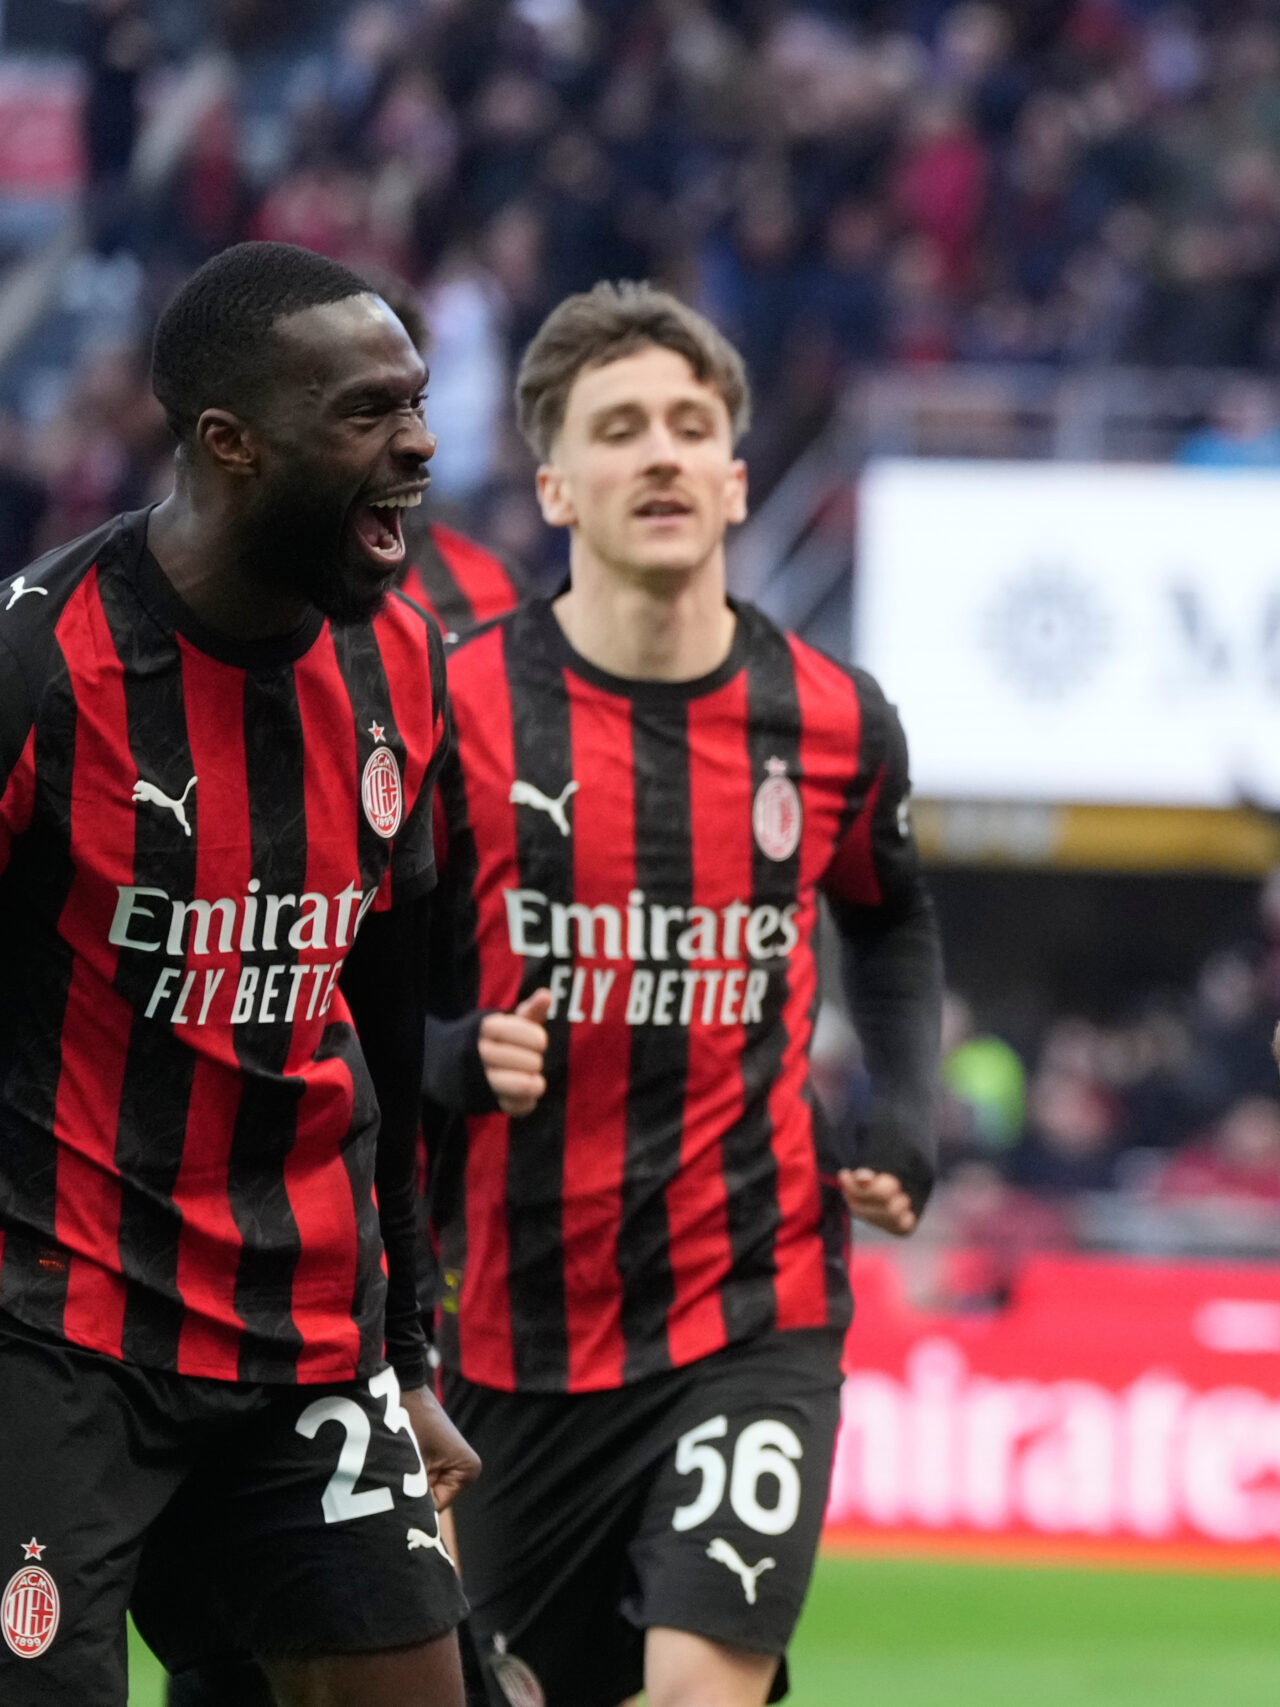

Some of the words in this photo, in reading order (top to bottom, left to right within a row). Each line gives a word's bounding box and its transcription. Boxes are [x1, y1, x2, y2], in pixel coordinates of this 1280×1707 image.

[503, 889, 799, 961] Emirates
[144, 966, 226, 1026] FLY
[547, 965, 617, 1025] FLY
[625, 968, 769, 1026] BETTER
[671, 1413, 803, 1536] 56
[16, 1573, 48, 1592] ACM
[14, 1635, 42, 1648] 1899
